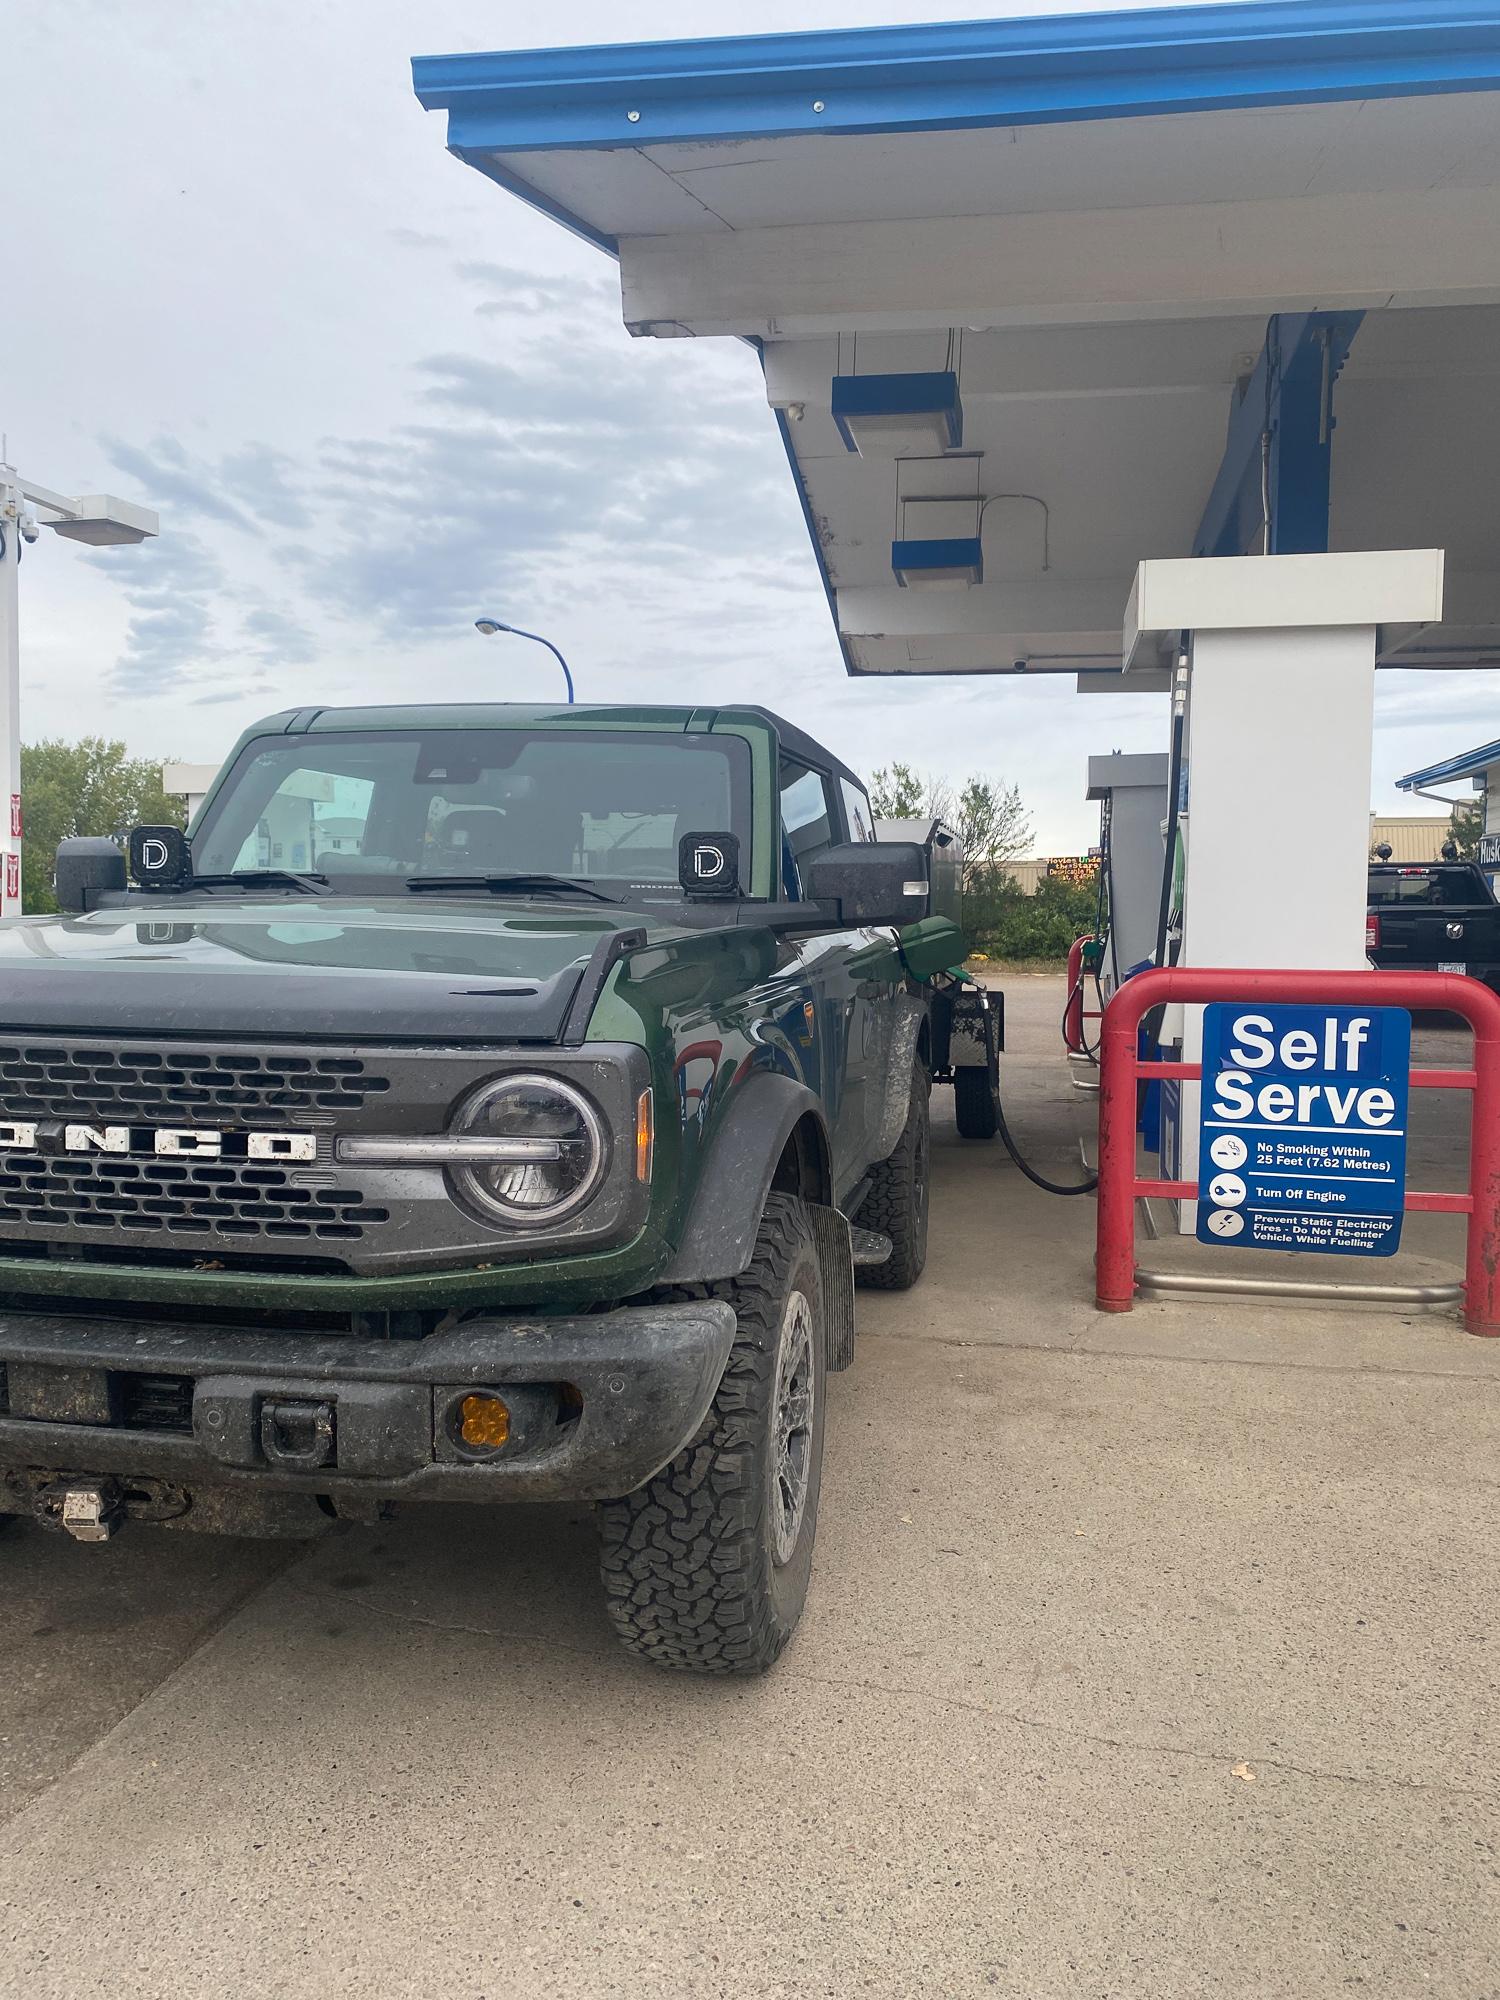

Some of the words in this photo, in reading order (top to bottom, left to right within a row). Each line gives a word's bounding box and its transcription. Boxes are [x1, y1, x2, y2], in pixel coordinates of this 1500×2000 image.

[142, 840, 168, 870] D
[694, 846, 724, 878] D
[1230, 1015, 1371, 1072] Self
[1212, 1070, 1395, 1127] Serve
[1257, 1142, 1273, 1152] No
[1276, 1144, 1328, 1157] Smoking
[1332, 1146, 1370, 1158] Within
[1256, 1155, 1273, 1164] 25
[1276, 1156, 1303, 1166] Feet
[1306, 1158, 1340, 1168] (7.62
[1343, 1159, 1390, 1172] Metres)
[1256, 1187, 1282, 1198] Turn
[1286, 1189, 1303, 1198] Off
[1306, 1190, 1346, 1202] Engine
[1254, 1214, 1298, 1224] Prevent
[1301, 1217, 1333, 1226] Static
[1336, 1220, 1392, 1231] Electricity
[1252, 1232, 1292, 1242] Vehicle
[1296, 1235, 1326, 1244] While
[1330, 1238, 1374, 1248] Fuelling
[1254, 1224, 1281, 1232] Fires
[1292, 1226, 1308, 1234] Do
[1312, 1227, 1332, 1236] Not
[1335, 1228, 1384, 1239] Re-enter
